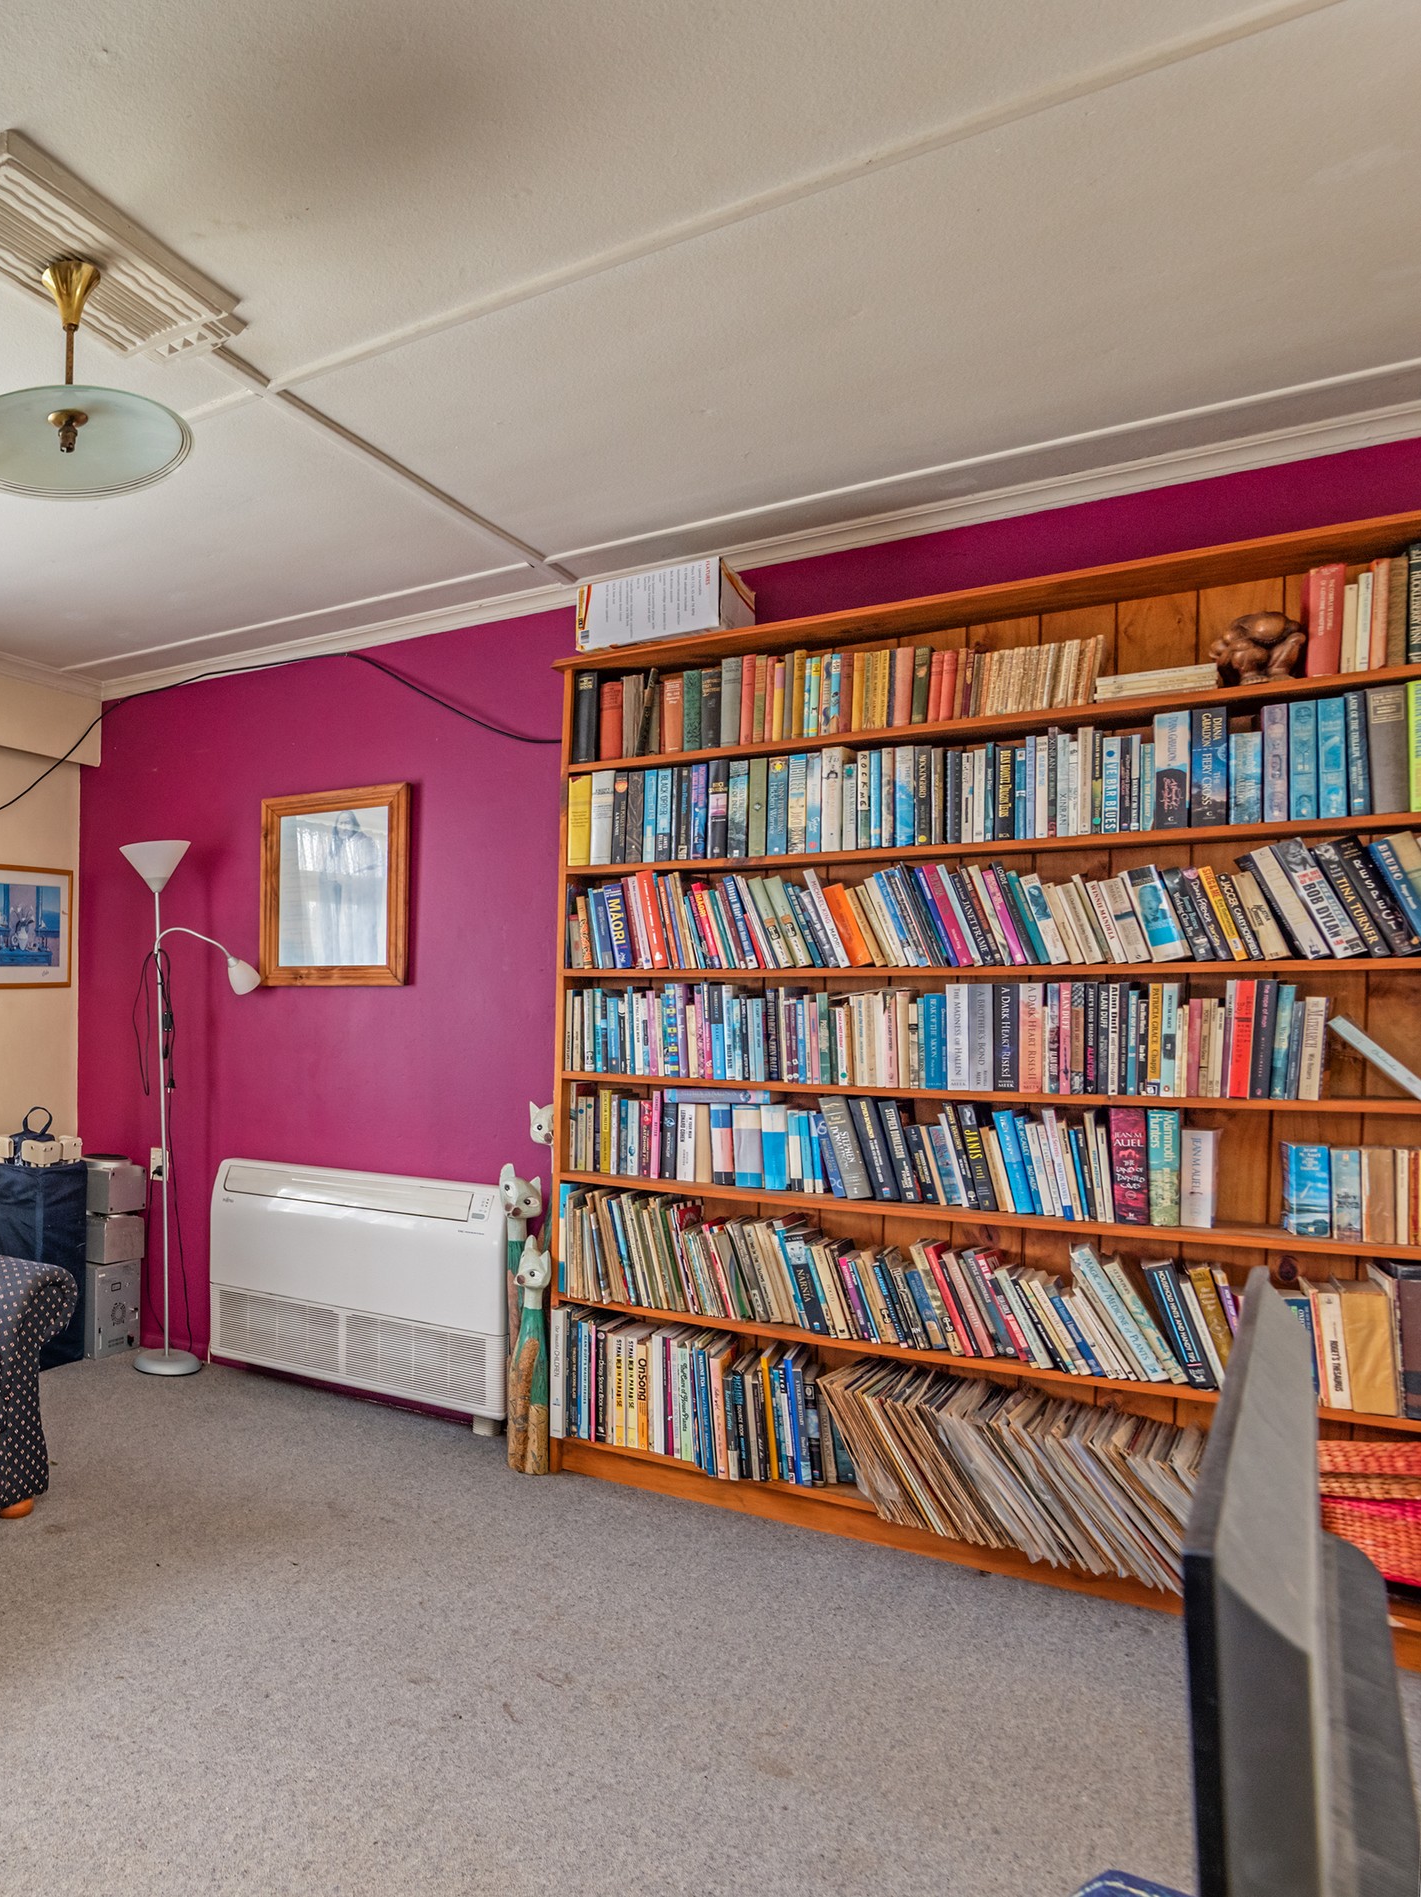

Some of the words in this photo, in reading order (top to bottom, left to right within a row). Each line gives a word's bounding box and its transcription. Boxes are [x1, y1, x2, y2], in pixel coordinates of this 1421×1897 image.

[1411, 570, 1421, 618] HUCKLEBERRY
[1410, 621, 1420, 645] FINN
[1202, 713, 1212, 747] GABALDON
[1212, 717, 1222, 741] DIANA
[1000, 750, 1011, 763] DEAN
[1202, 753, 1212, 774] FIERY
[660, 774, 668, 794] BLACK
[790, 758, 805, 791] JUBILEE
[918, 754, 927, 798] MOCKINGBIRD
[1000, 765, 1011, 783] KOONTZ
[1104, 778, 1118, 798] BAR
[1201, 777, 1212, 805] CROSS
[659, 795, 668, 816] ORDER
[1058, 793, 1067, 826] XINRAN
[1104, 801, 1118, 829] BLUES
[769, 809, 777, 835] Warrior
[996, 866, 1008, 884] LORDE
[1377, 844, 1403, 880] BRUNO
[1352, 859, 1398, 930] RESPECT
[1090, 884, 1101, 908] WINNIE
[1099, 909, 1114, 940] MANDELA
[1303, 883, 1323, 905] BOB
[1314, 906, 1342, 939] DYLAN
[1336, 877, 1354, 902] TINA
[1351, 904, 1378, 944] TURNER
[961, 901, 979, 925] JANET
[971, 926, 989, 953] FRAME
[1183, 926, 1193, 936] Boy
[1001, 995, 1010, 1019] DARK
[1027, 995, 1036, 1017] DARK
[1062, 989, 1070, 1009] ALAN
[1100, 991, 1108, 1009] ALAN
[1151, 988, 1159, 1019] PATRICIA
[954, 1001, 962, 1036] MADNESS
[977, 999, 986, 1040] BROTHER'S
[1062, 1011, 1070, 1030] DUFF
[1100, 1011, 1108, 1028] DUFF
[1304, 1009, 1323, 1048] MATRIARCH
[1001, 1022, 1011, 1048] HEART
[1027, 1020, 1036, 1048] HEART
[1151, 1021, 1159, 1044] GRACE
[768, 1040, 776, 1056] JOHN
[978, 1042, 986, 1065] BOND
[1049, 1051, 1058, 1063] ALAN
[954, 1047, 963, 1076] HALLEN
[1050, 1064, 1058, 1076] DUFF
[1150, 1049, 1158, 1074] Chappy
[885, 1109, 899, 1130] STEPHEN
[1150, 1114, 1162, 1148] Hunters
[840, 1131, 855, 1163] STEPHEN
[889, 1130, 905, 1159] DONALDSON
[964, 1129, 982, 1160] JANIS
[1114, 1139, 1144, 1147] AUEL
[1163, 1114, 1175, 1162] Mammoth
[1191, 1137, 1202, 1153] JEAN
[1029, 1176, 1038, 1191] MUSIC
[797, 1269, 811, 1303] NARNIA
[873, 1266, 888, 1295] OUTLANDERS
[968, 1258, 980, 1276] LITTLE
[974, 1276, 991, 1303] CRIMINALS
[1157, 1270, 1176, 1303] HOUSEHOLD
[1082, 1257, 1097, 1280] MAGIC
[1105, 1294, 1129, 1326] MEDICINE
[1130, 1334, 1150, 1360] PLANTS
[1169, 1303, 1181, 1319] HINTS
[1174, 1319, 1184, 1331] AND
[1179, 1332, 1191, 1351] HANDY
[1330, 1340, 1341, 1360] ROGET'S
[1185, 1351, 1197, 1362] TIPS
[637, 1358, 647, 1401] OnSong
[1332, 1362, 1343, 1391] THESAURUS
